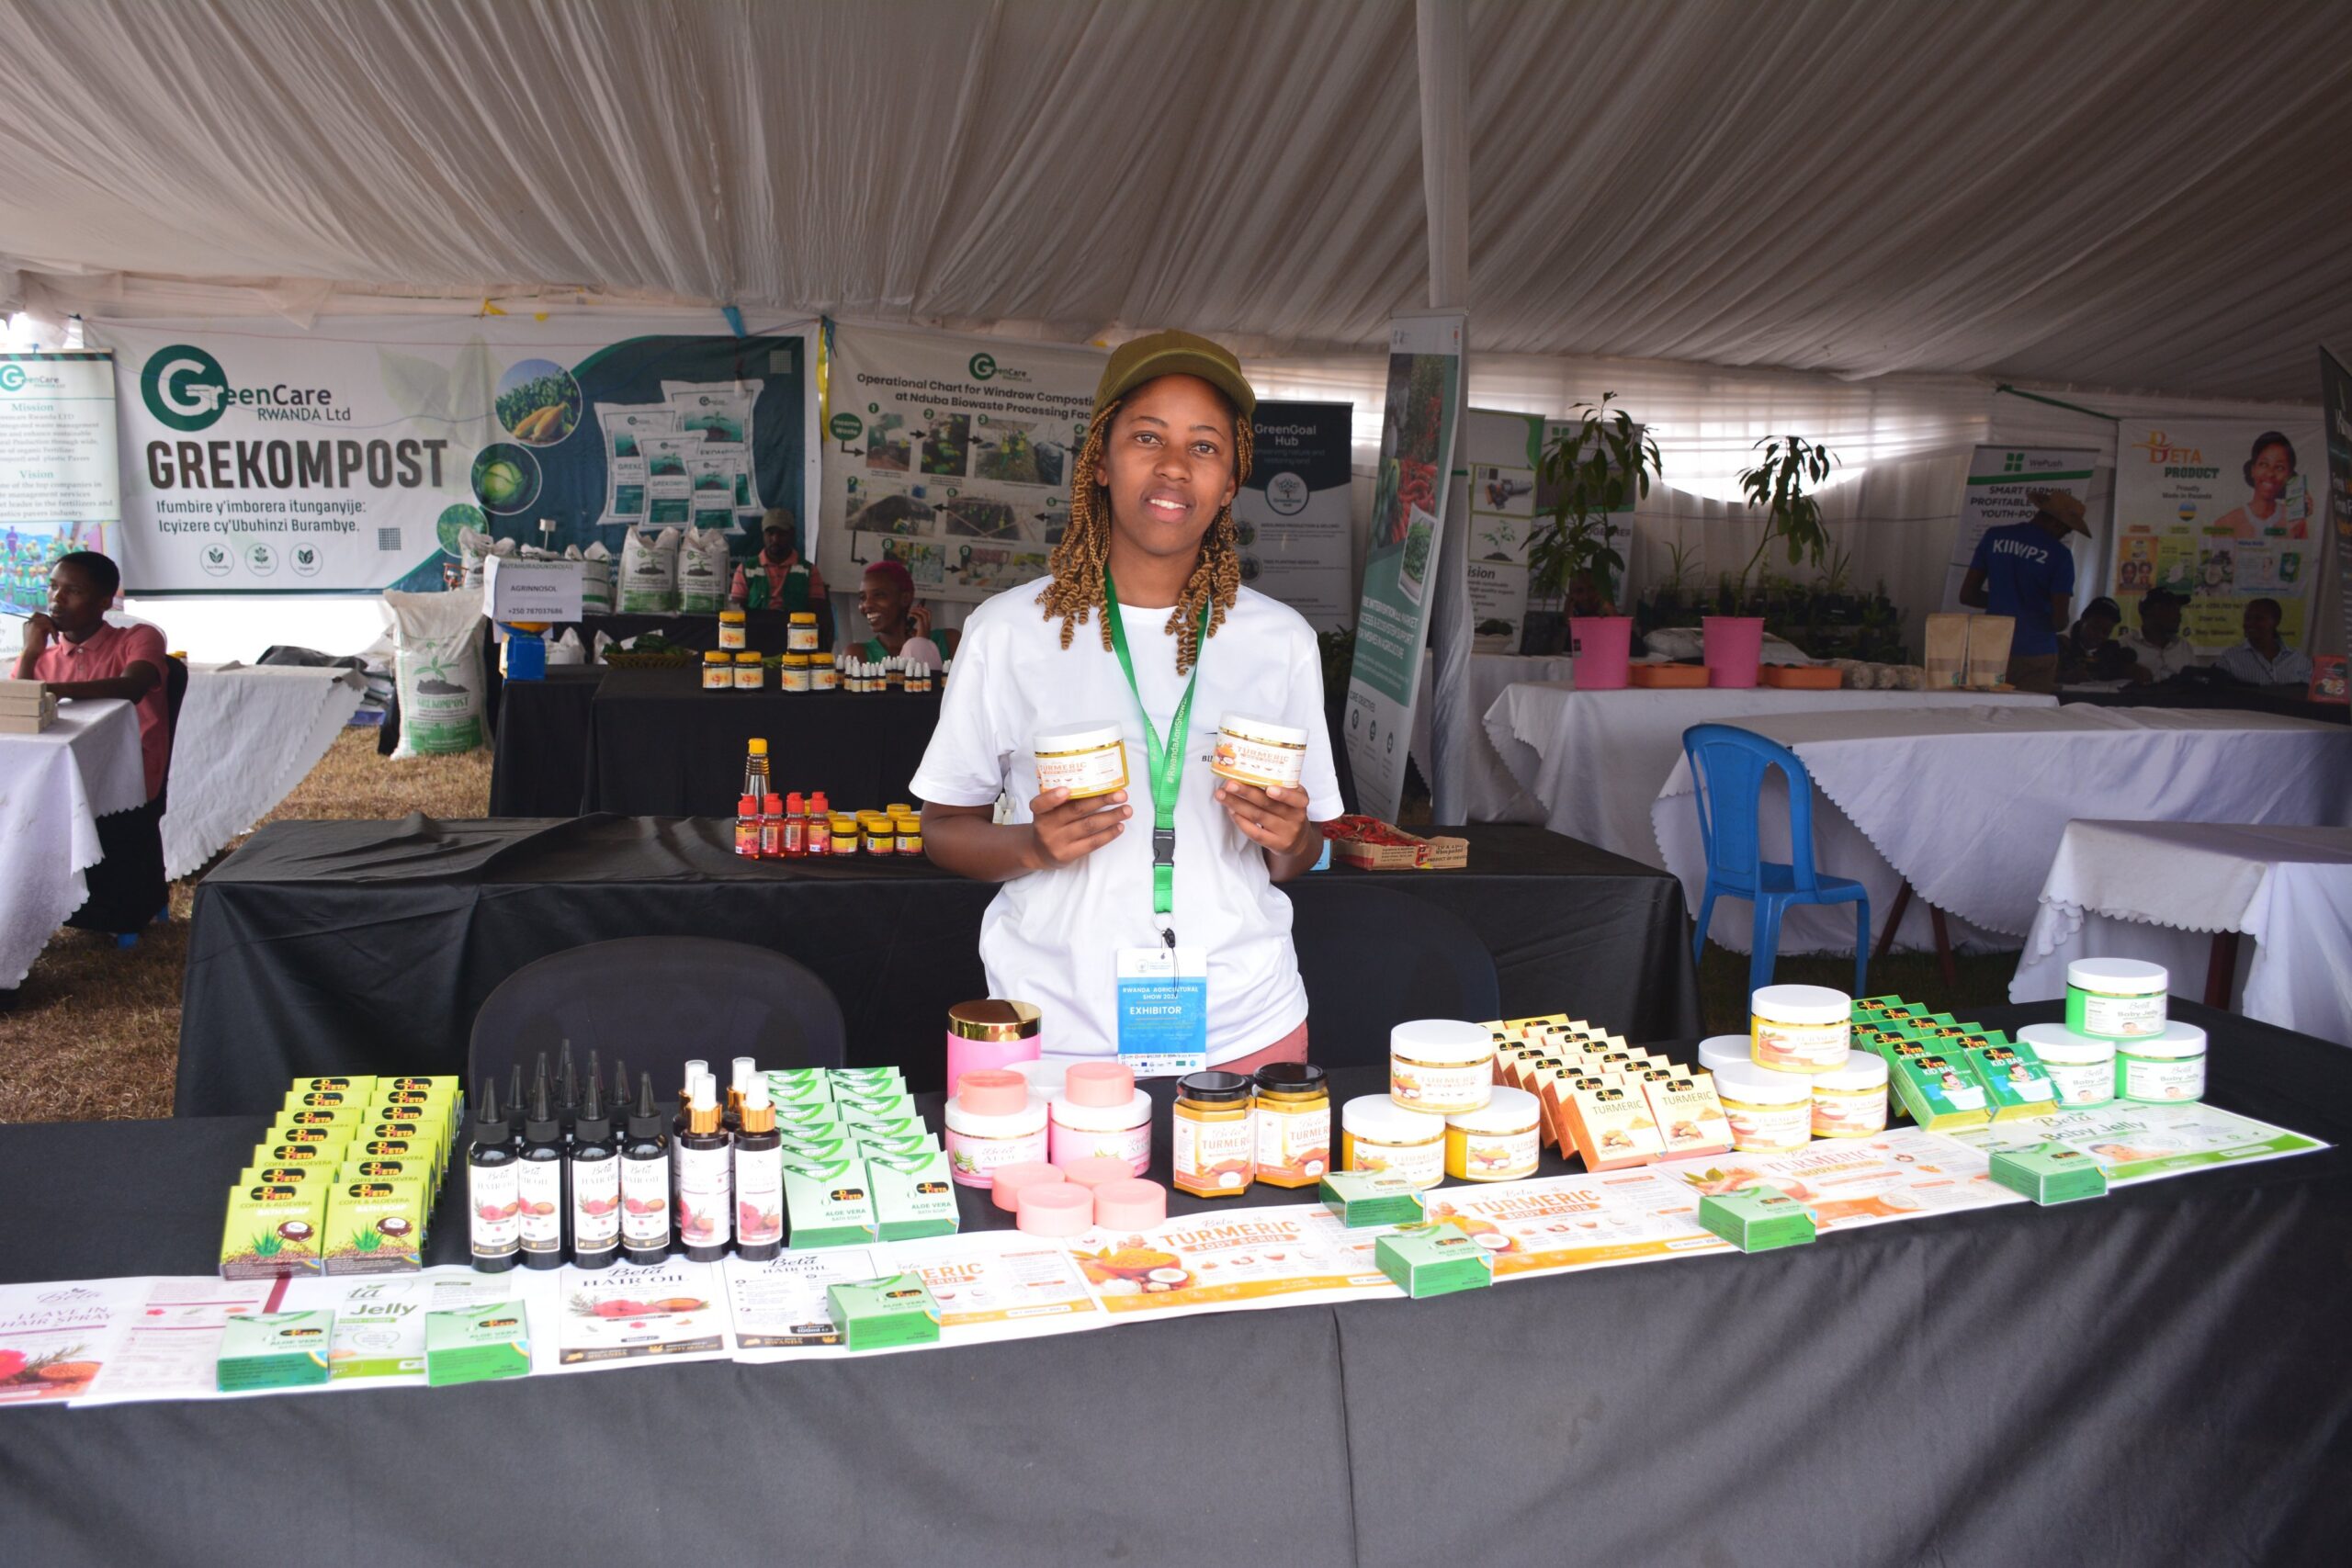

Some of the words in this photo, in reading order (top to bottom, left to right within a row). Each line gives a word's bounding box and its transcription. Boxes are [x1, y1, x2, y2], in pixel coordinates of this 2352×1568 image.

[158, 357, 332, 417] GreenCare
[857, 373, 927, 389] Operational
[929, 380, 963, 393] Chart
[965, 384, 982, 395] for
[984, 386, 1035, 400] Windrow
[11, 402, 53, 412] Mission
[896, 391, 908, 401] at
[910, 393, 949, 406] Nduba
[951, 397, 1004, 412] Biowaste
[1006, 403, 1069, 421] Processing
[257, 407, 322, 422] RWANDA
[326, 407, 352, 421] Ltd
[925, 411, 933, 419] 2
[1254, 423, 1317, 435] GreenGoal
[1274, 435, 1299, 446] Hub
[147, 438, 448, 490] GREKOMPOST
[19, 470, 54, 479] Vision
[2165, 467, 2220, 479] PRODUCT
[1989, 486, 2024, 495] SMART
[156, 500, 213, 513] Ifumbire
[215, 500, 287, 516] y'imborera
[288, 500, 368, 516] itunganyije:
[158, 519, 210, 535] Icyizere
[213, 519, 288, 535] cy'Ubuhinzi
[291, 519, 360, 535] Burambye.
[1992, 538, 2049, 564] KIIWP2
[1238, 747, 1291, 762] TURMERIC
[1039, 761, 1087, 773] TURMERIC
[1129, 1006, 1182, 1015] EXHIBITOR
[1990, 1059, 2005, 1067] KID
[2006, 1056, 2024, 1065] BAR
[1922, 1067, 1937, 1076] KID
[1938, 1066, 1957, 1074] BAR
[2073, 1078, 2097, 1087] Baby
[1661, 1091, 1713, 1105] TURMERIC
[1591, 1100, 1644, 1114] TURMERIC
[2032, 1112, 2097, 1128] Beta
[1289, 1126, 1329, 1141] TURMER
[2039, 1126, 2096, 1142] Baby
[2100, 1120, 2147, 1135] Jelly
[1762, 1150, 1877, 1173] TURMERIC
[1466, 1189, 1601, 1215] TURMERIC
[1505, 1209, 1544, 1220] BODY
[1549, 1202, 1591, 1215] SCRUB
[1159, 1221, 1302, 1247] TURMERIC
[1196, 1238, 1235, 1251] BODY
[1238, 1234, 1286, 1245] SCRUB
[899, 1262, 985, 1279] ERIC
[582, 1276, 642, 1287] HAIR
[650, 1274, 690, 1285] OIL
[18, 1308, 83, 1320] LEAVE
[350, 1303, 419, 1317] Jelly
[1, 1318, 49, 1328] HAIR
[55, 1314, 115, 1325] SPRAY
[493, 1329, 518, 1337] VERA
